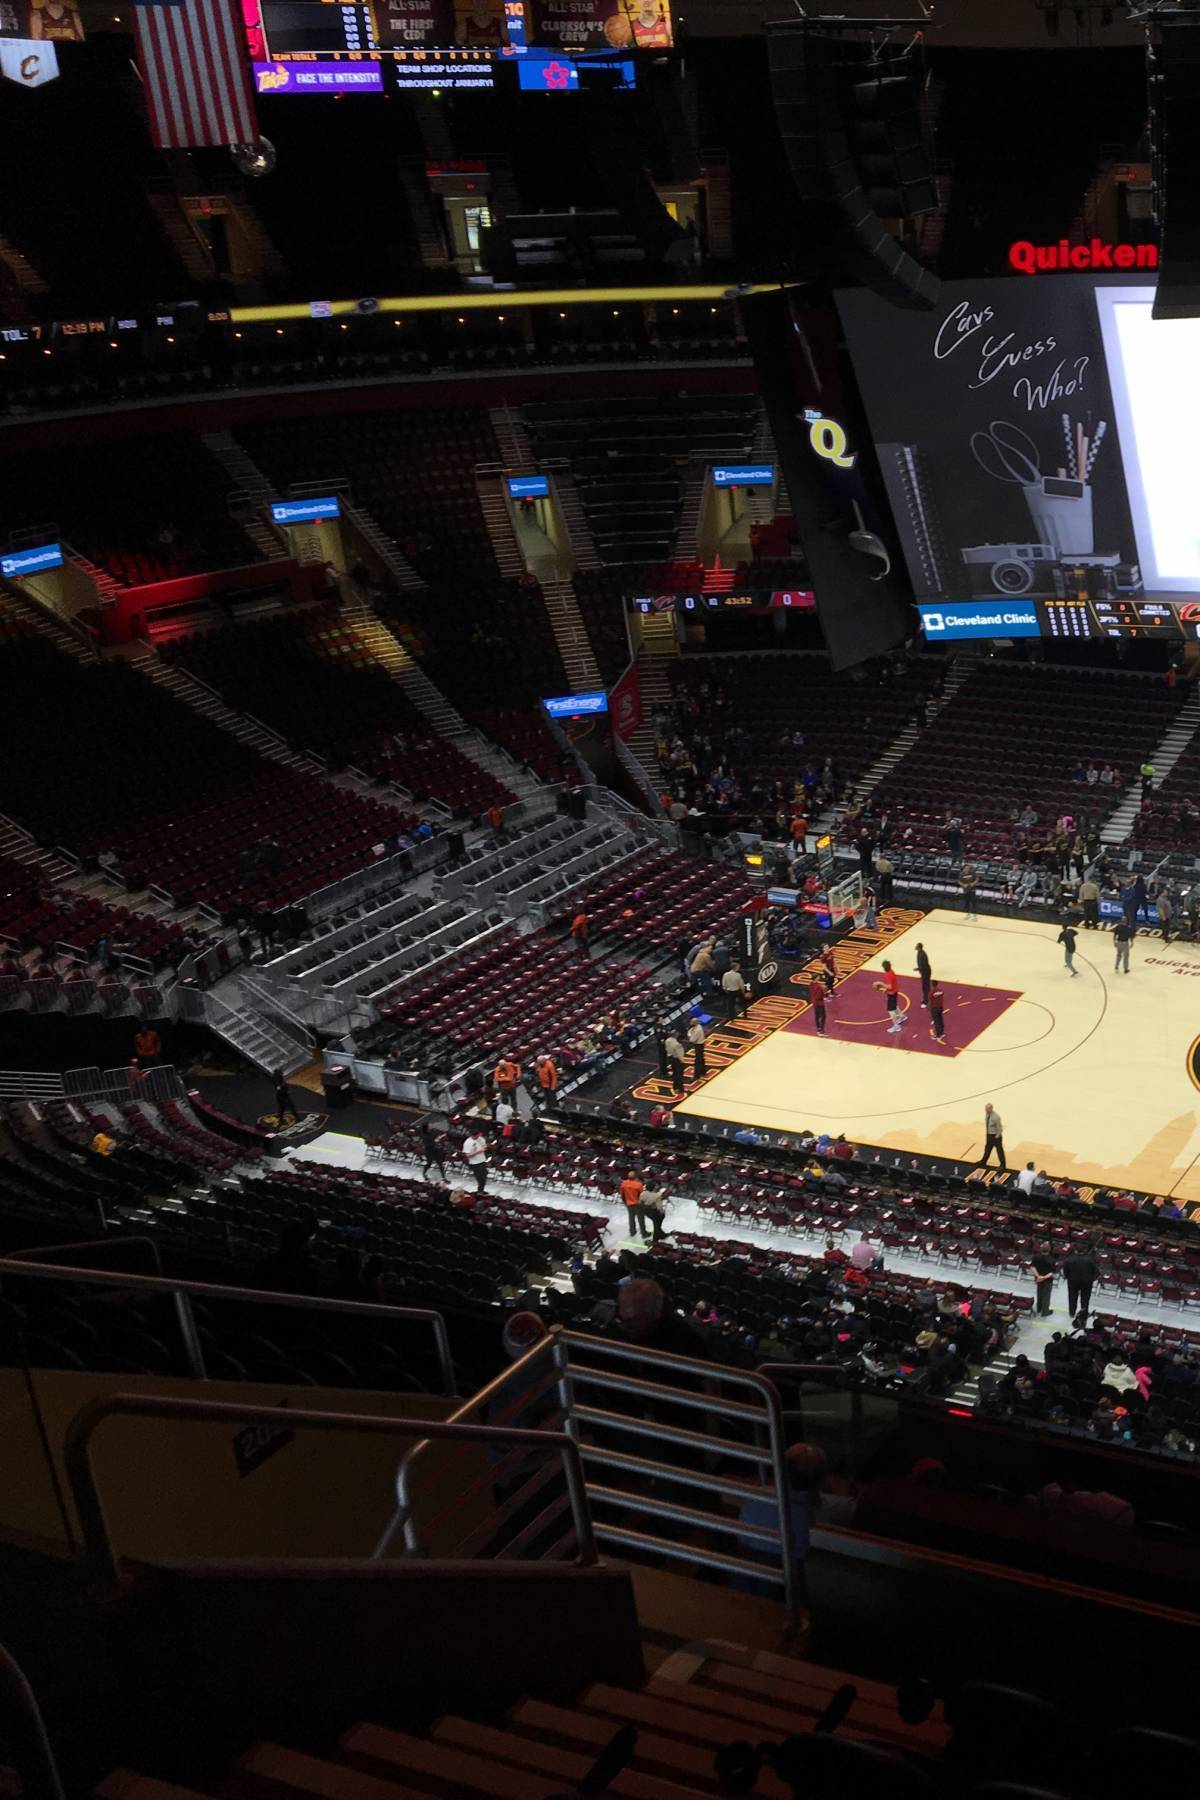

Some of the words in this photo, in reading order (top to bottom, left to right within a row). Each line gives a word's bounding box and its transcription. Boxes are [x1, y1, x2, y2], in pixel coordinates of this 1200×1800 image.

[390, 19, 408, 29] THE
[410, 19, 434, 29] FIRST
[396, 64, 421, 73] TEAM
[422, 64, 445, 73] SHOP
[446, 64, 492, 72] LOCATIONS
[295, 73, 318, 84] FACE
[318, 73, 335, 84] THE
[335, 72, 380, 83] INTENSITY!
[396, 80, 454, 88] THROUGHOUT
[1009, 238, 1157, 274] Quicken
[1013, 356, 1090, 411] Who?
[809, 418, 855, 468] Q
[685, 598, 694, 609] 0
[945, 614, 1002, 627] Cleveland
[1003, 613, 1037, 624] Clinic
